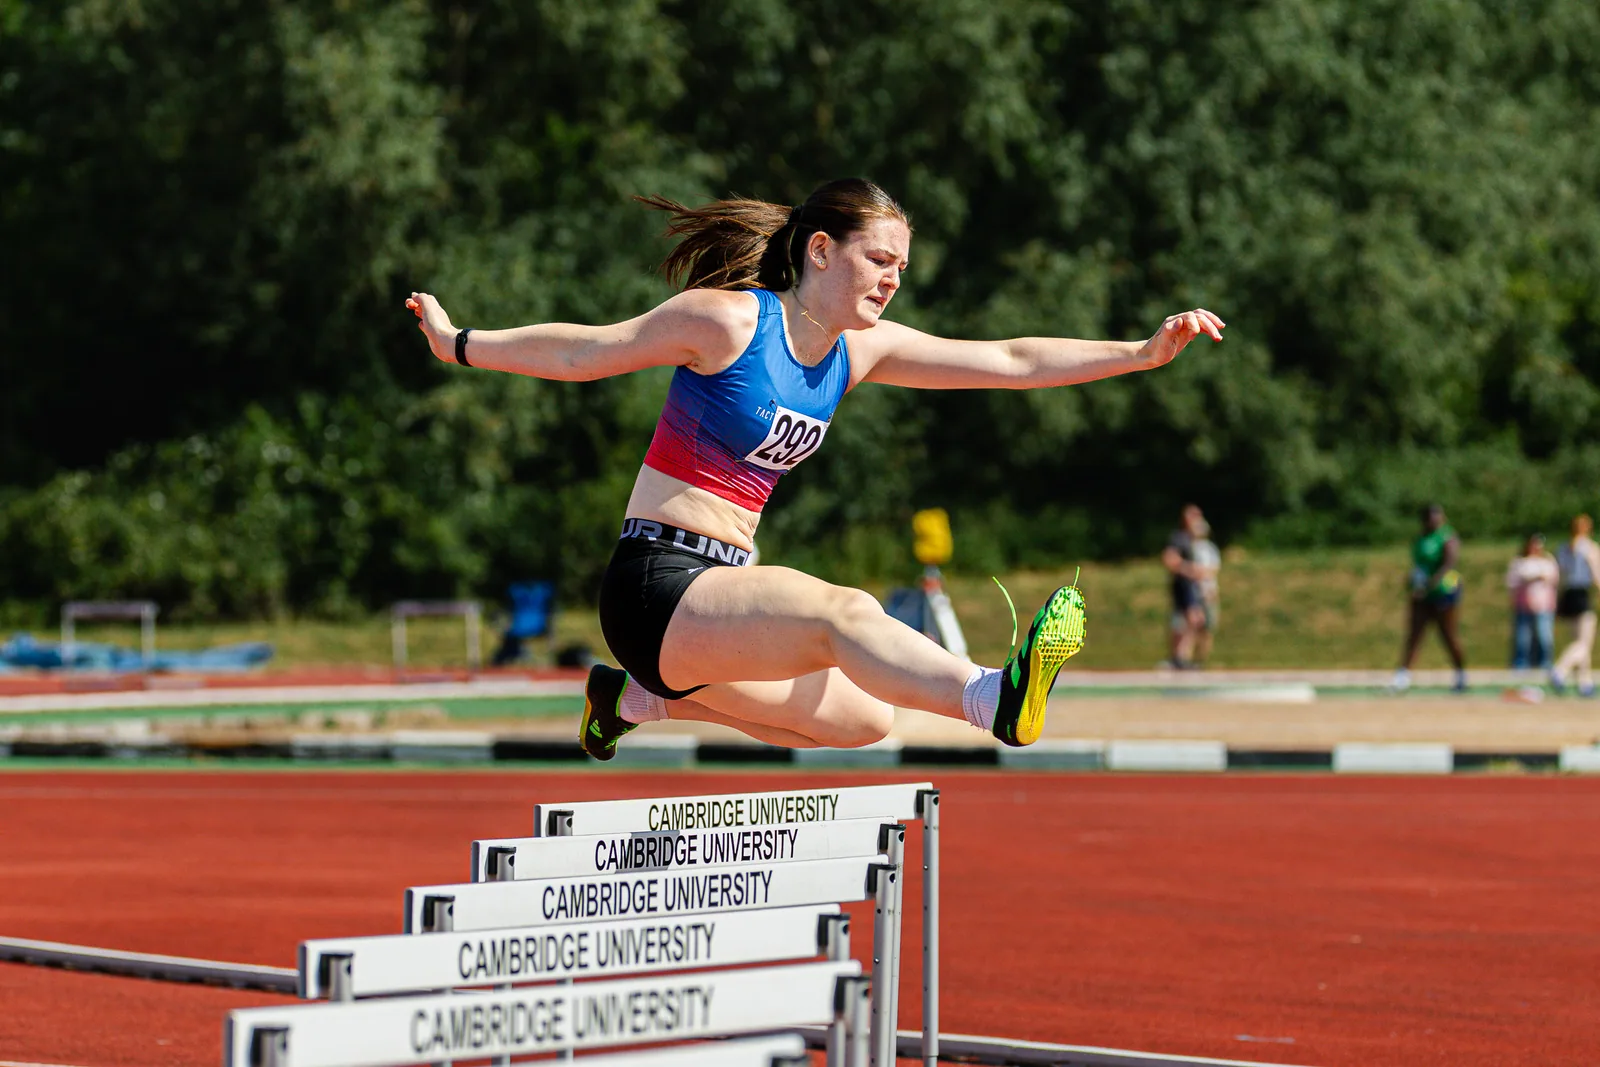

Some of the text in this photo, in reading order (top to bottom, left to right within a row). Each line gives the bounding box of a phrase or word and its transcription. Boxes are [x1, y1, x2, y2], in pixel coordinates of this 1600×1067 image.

[754, 414, 821, 465] 292
[648, 794, 839, 832] CAMBRIDGE UNIVERSITY
[595, 828, 798, 871] CAMBRIDGE UNIVERSITY
[541, 870, 773, 920] CAMBRIDGE UNIVERSITY
[458, 923, 715, 980] CAMBRIDGE UNIVERSITY
[410, 985, 715, 1054] CAMBRIDGE UNIVERSITY
